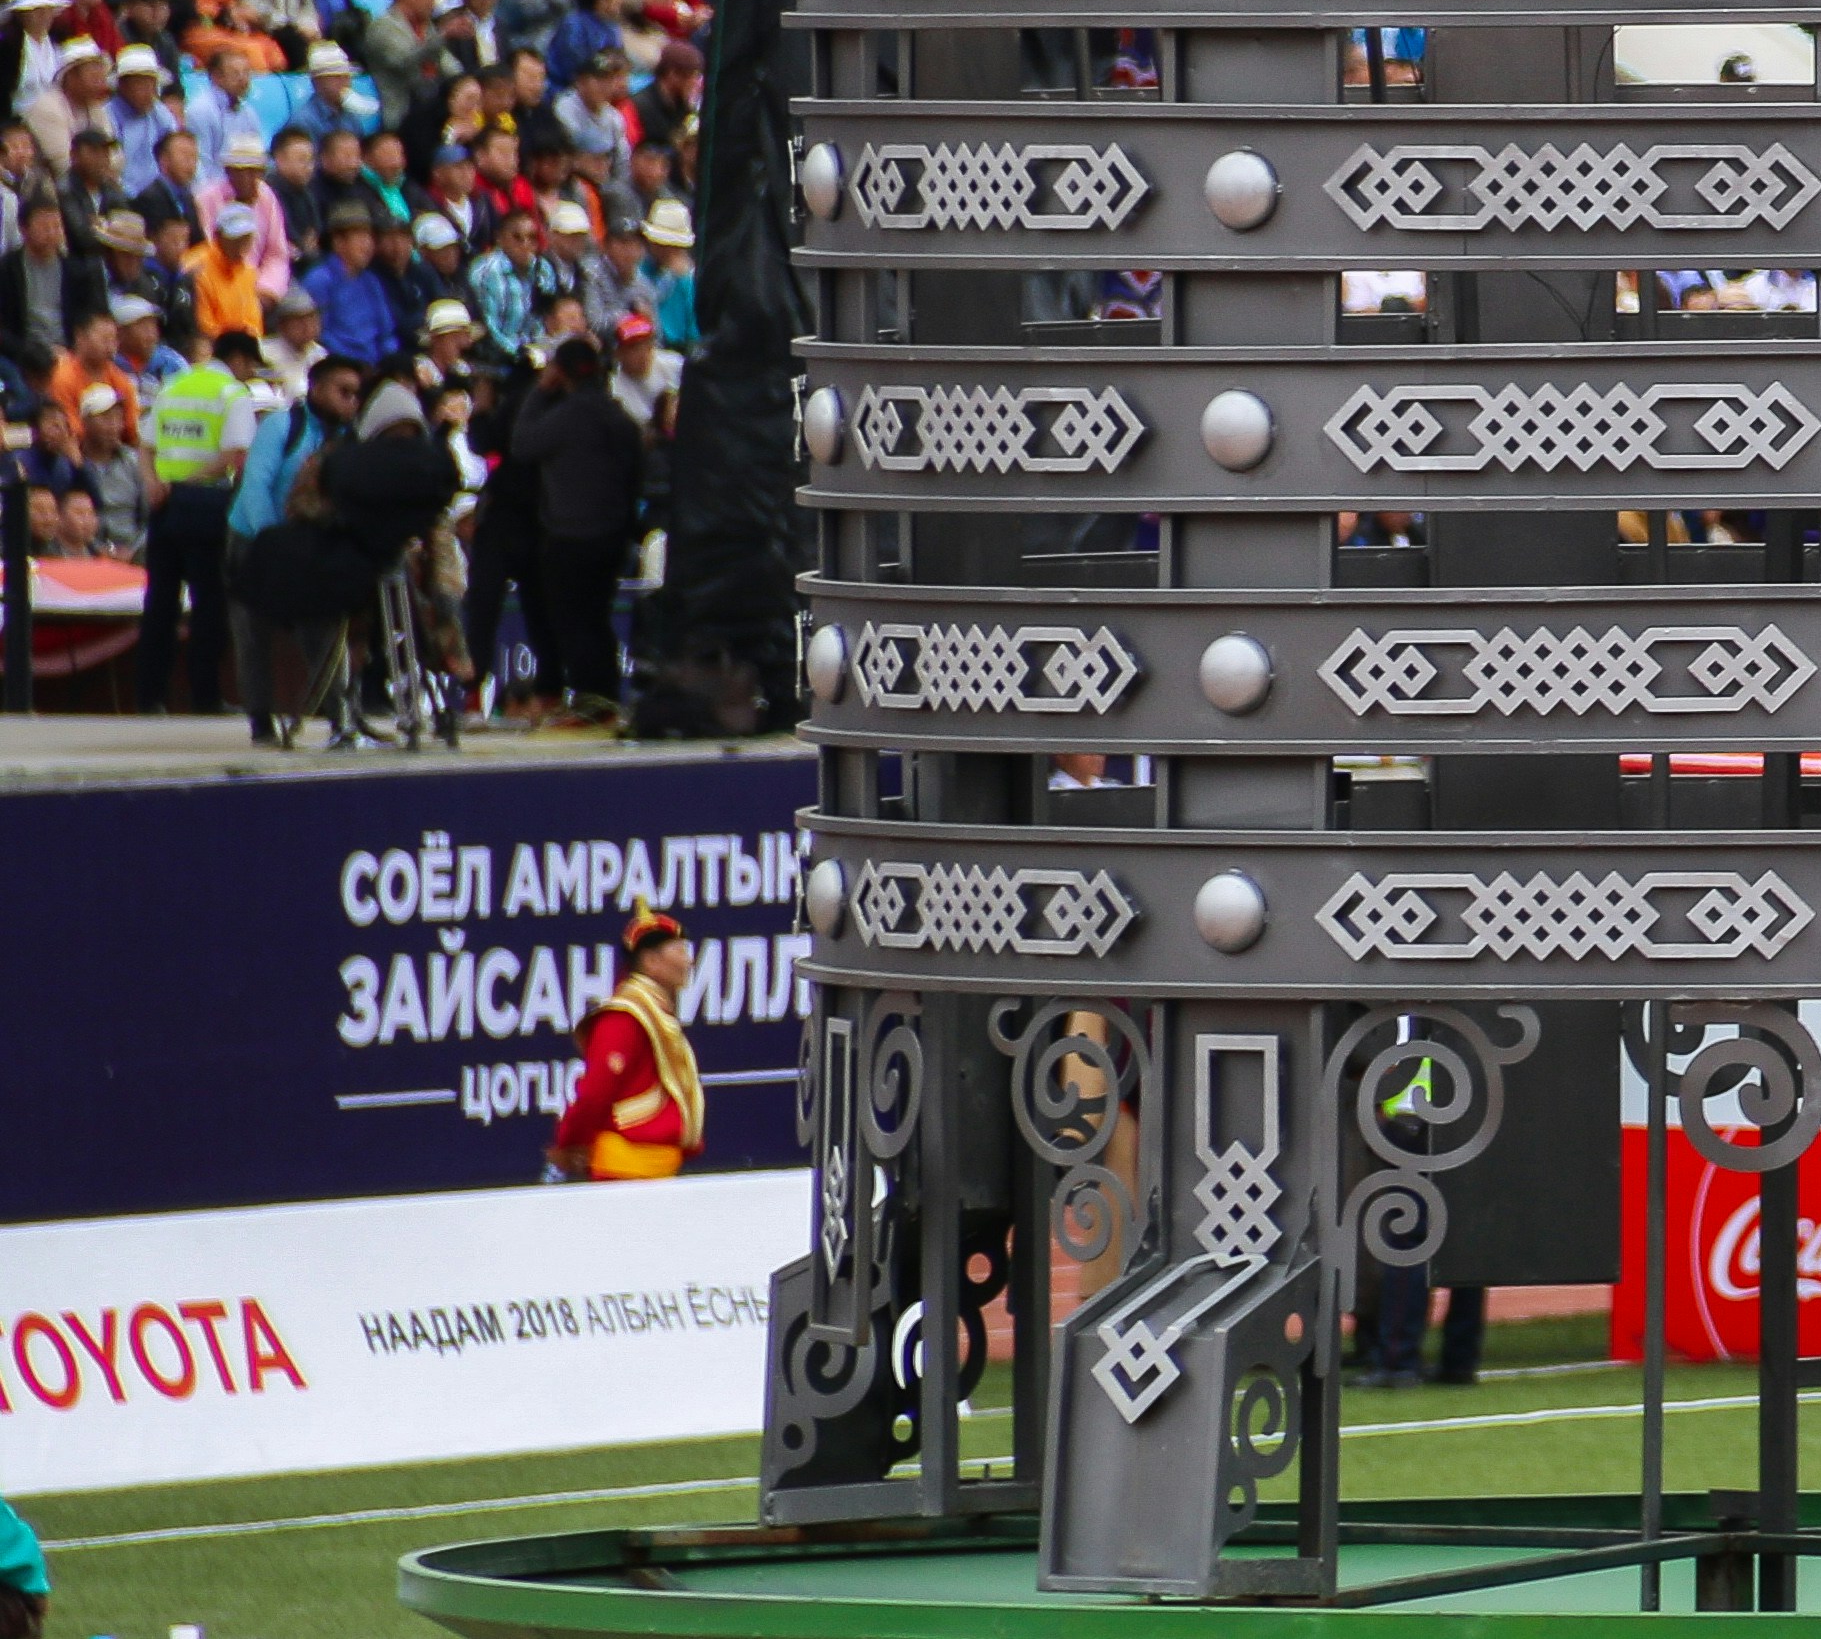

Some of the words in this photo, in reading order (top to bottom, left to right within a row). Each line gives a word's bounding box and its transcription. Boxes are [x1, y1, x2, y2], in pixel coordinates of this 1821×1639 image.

[340, 830, 492, 927] СОЁЛ
[336, 928, 615, 1048] ЗАЙСАН
[673, 933, 813, 1025] ИЛЛ
[0, 1296, 309, 1413] OYOTA
[358, 1302, 506, 1357] НААДАМ
[509, 1297, 580, 1340] 2018
[584, 1290, 687, 1337] АЛБАН
